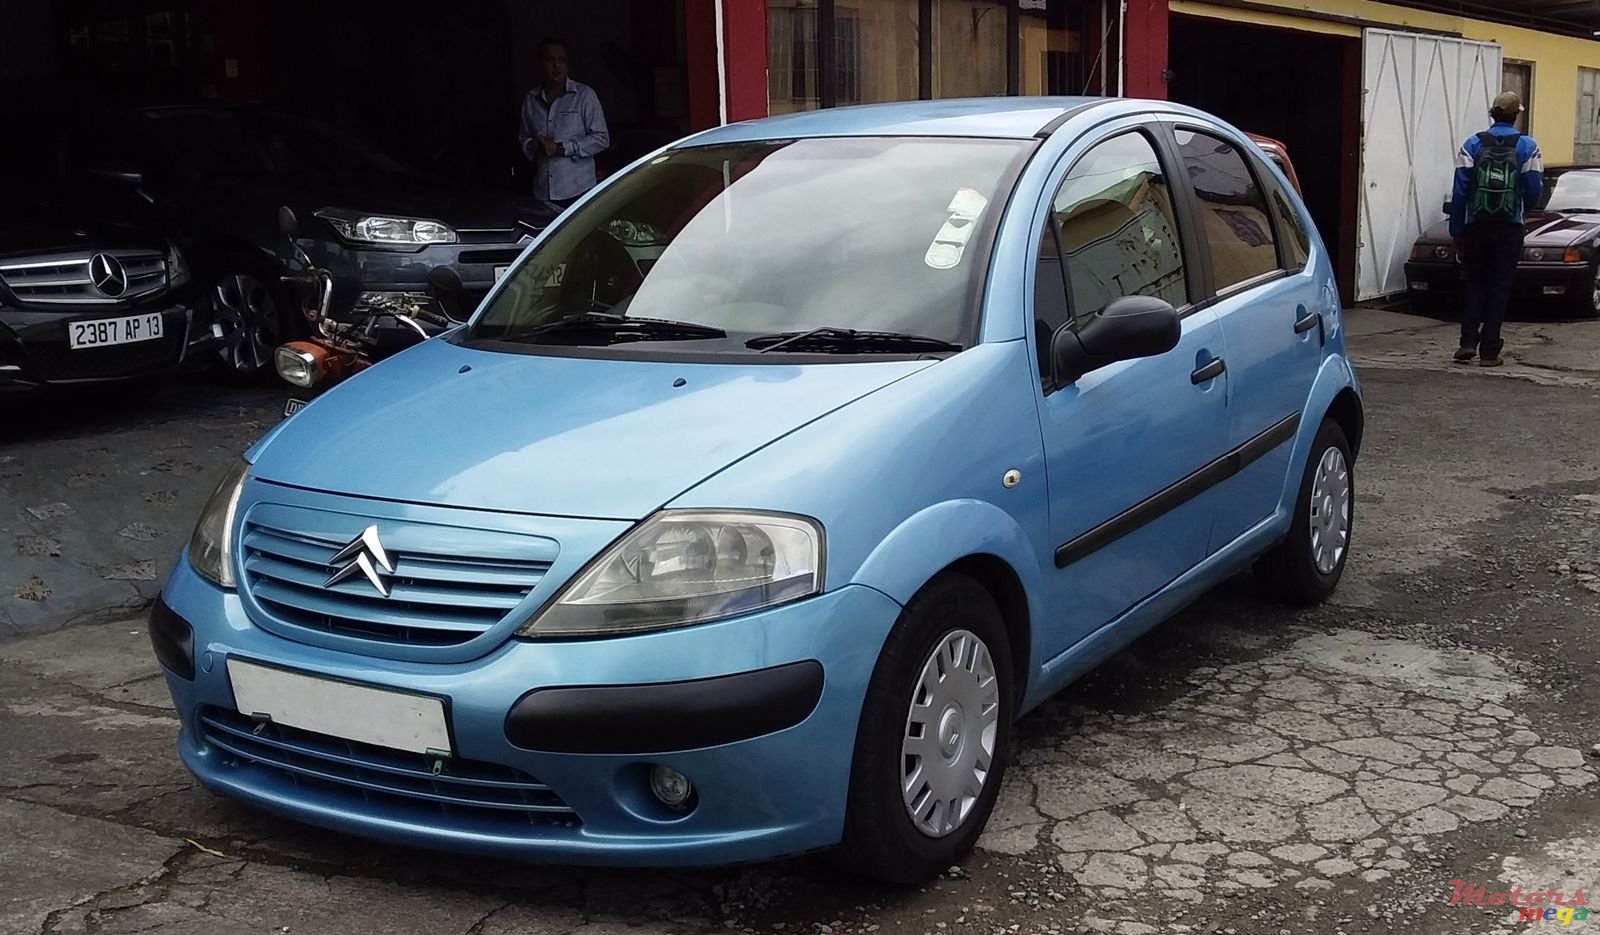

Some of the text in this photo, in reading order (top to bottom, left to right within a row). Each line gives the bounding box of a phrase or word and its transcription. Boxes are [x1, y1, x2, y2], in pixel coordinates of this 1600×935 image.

[75, 315, 160, 345] 2387 AP 13
